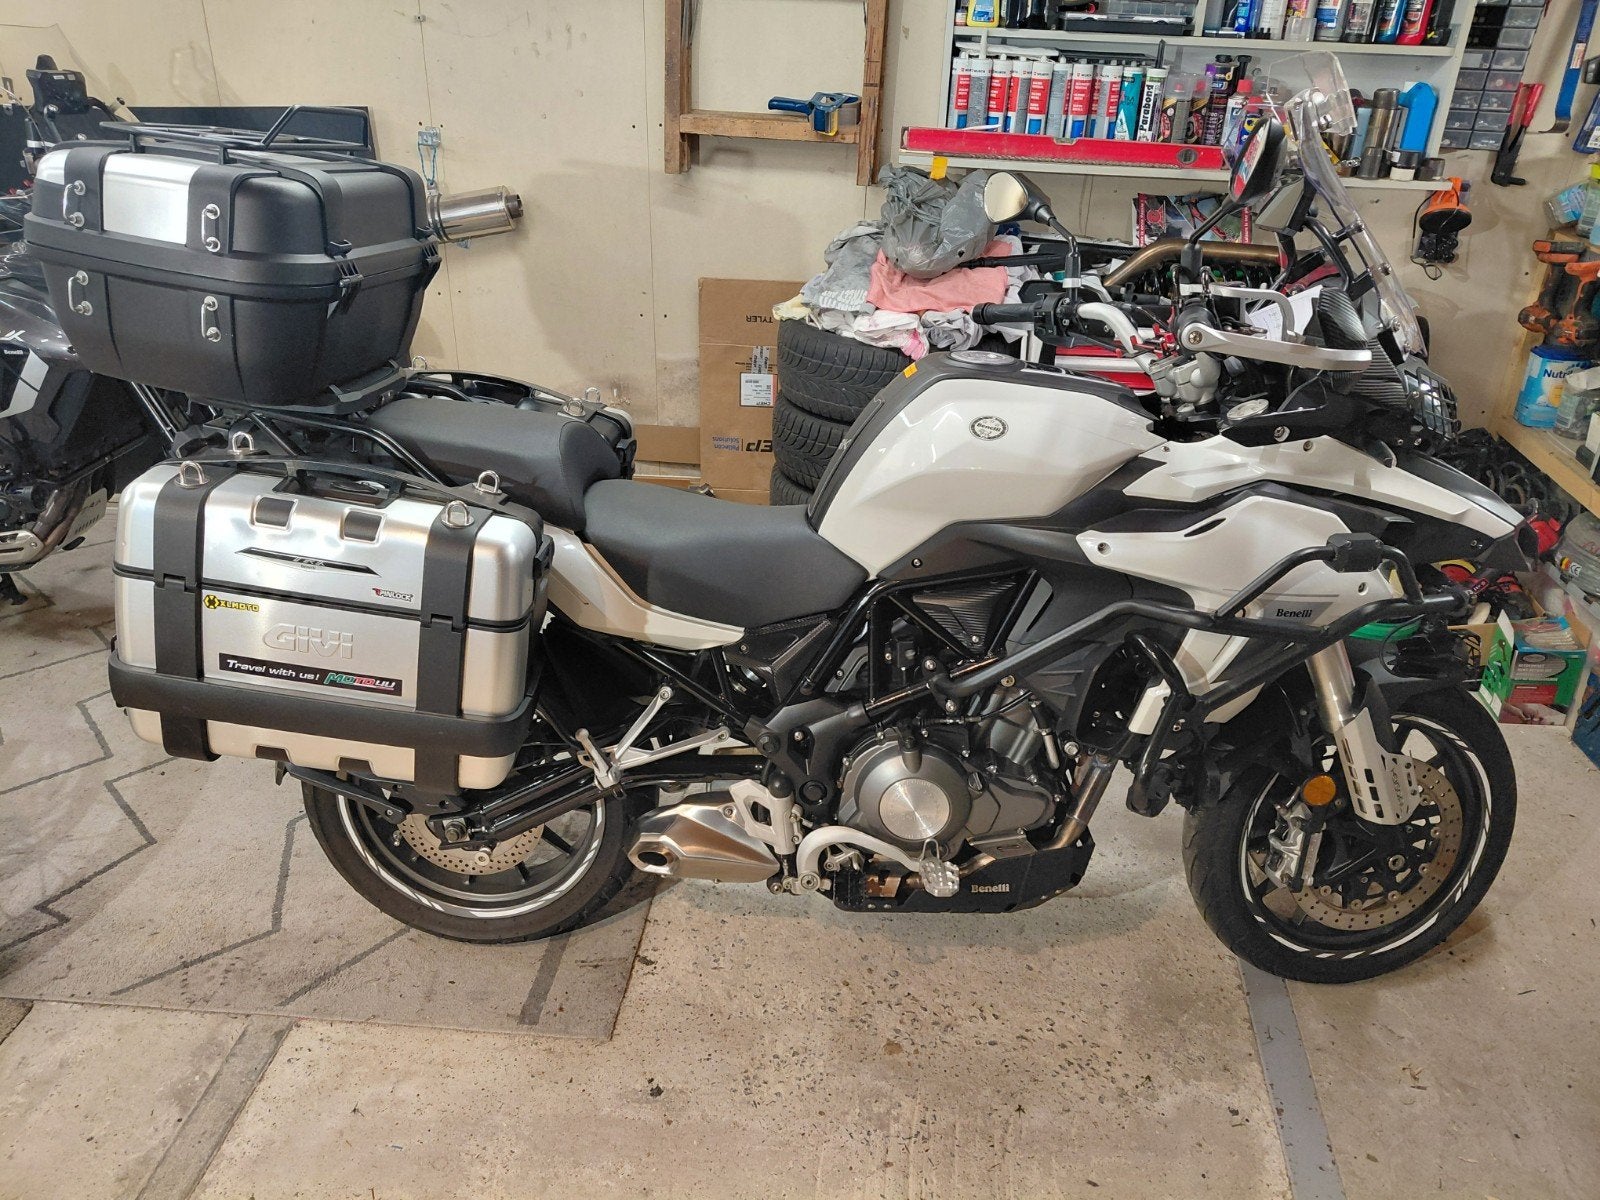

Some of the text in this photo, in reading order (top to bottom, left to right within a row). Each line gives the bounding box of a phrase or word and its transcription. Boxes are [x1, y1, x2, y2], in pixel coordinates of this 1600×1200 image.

[1138, 84, 1154, 132] Parabond
[745, 314, 774, 324] TYLER
[380, 589, 414, 602] PINLOCK
[219, 599, 260, 613] XLMOTO
[1275, 607, 1313, 618] Benelli
[262, 623, 354, 660] GIVI
[226, 658, 267, 673] Travel
[268, 667, 296, 678] with
[298, 672, 320, 681] us!
[970, 883, 1010, 893] Benelli
